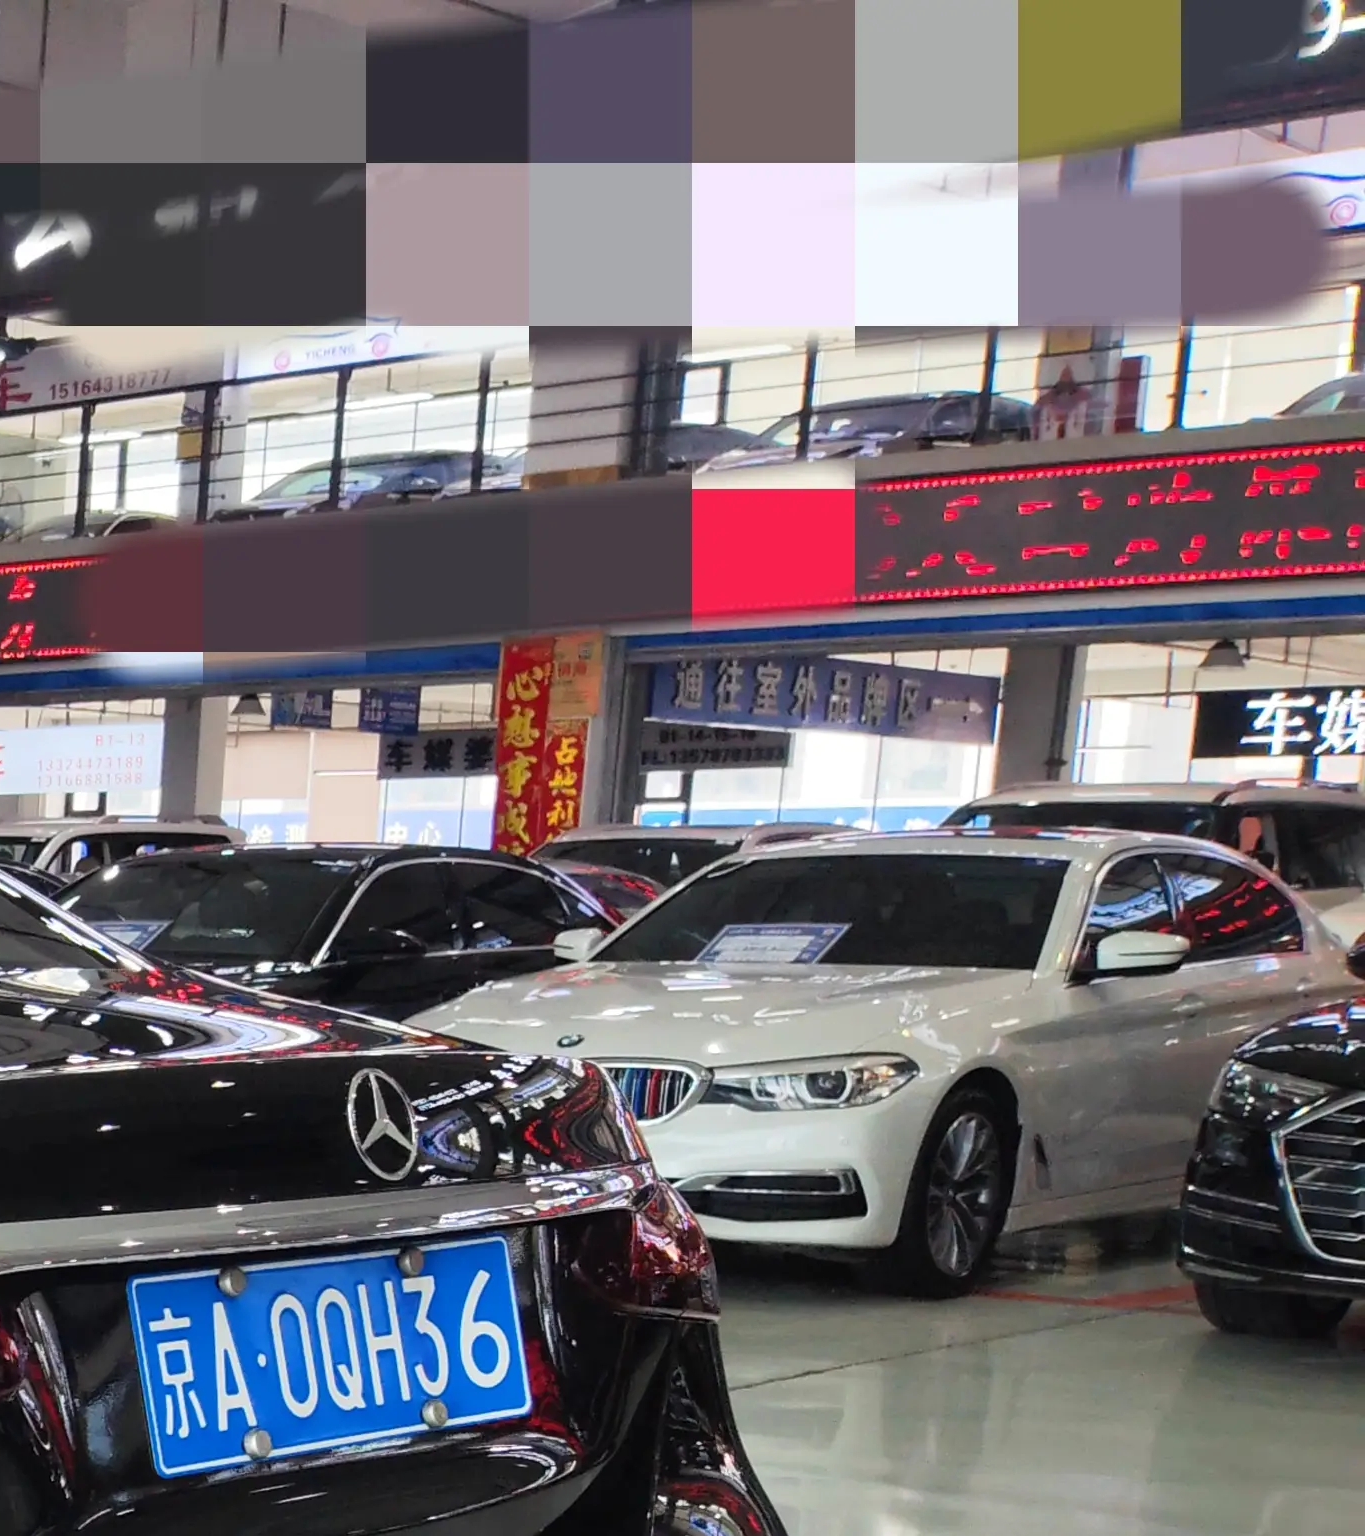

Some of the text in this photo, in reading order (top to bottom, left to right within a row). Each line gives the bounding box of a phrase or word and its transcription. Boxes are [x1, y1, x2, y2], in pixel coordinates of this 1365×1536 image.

[305, 344, 356, 360] YICHENG
[674, 659, 922, 728] 通往室外品牌区
